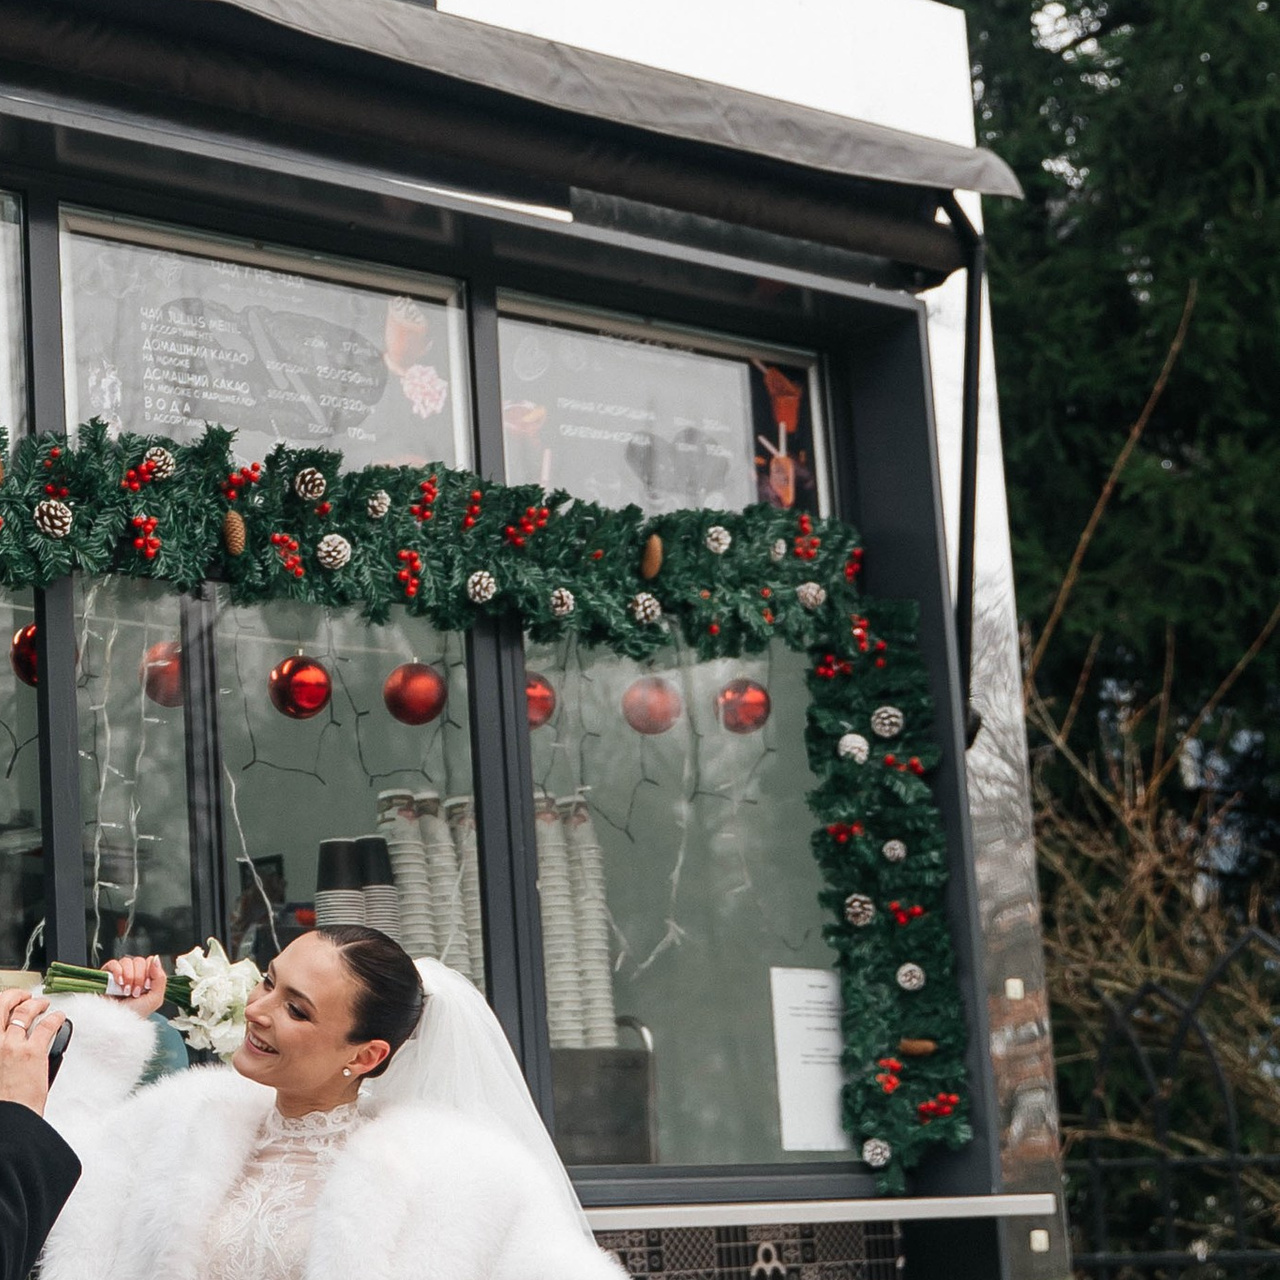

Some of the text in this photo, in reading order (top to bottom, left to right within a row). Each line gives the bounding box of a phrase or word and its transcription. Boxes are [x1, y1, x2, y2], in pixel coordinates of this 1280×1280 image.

[210, 348, 250, 366] КАКАО
[212, 378, 251, 395] КАКАО
[144, 396, 191, 415] ВОДА
